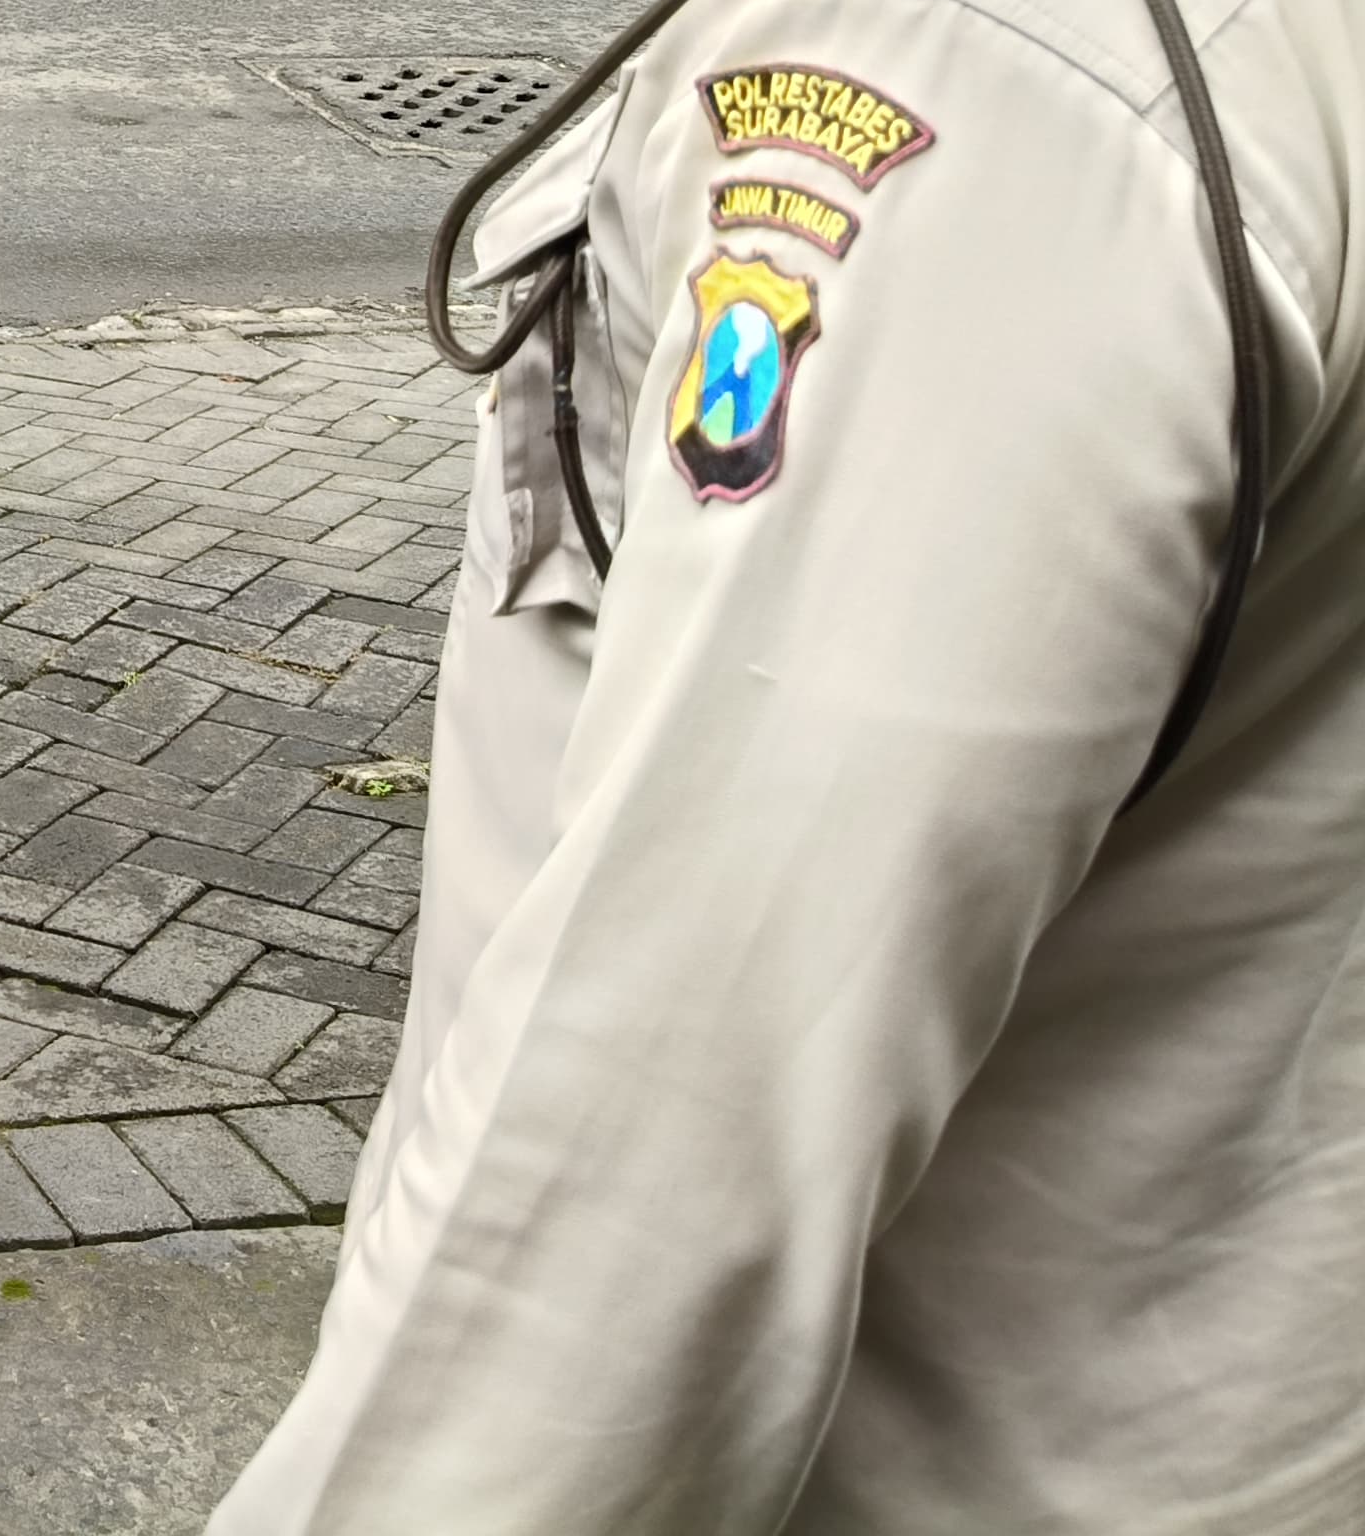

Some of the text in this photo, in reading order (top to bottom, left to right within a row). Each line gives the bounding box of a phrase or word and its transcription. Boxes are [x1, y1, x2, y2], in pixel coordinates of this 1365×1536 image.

[713, 72, 912, 152] POLRESTABES
[725, 107, 878, 174] SURABAYA
[719, 185, 850, 244] JAWA TIMUR
